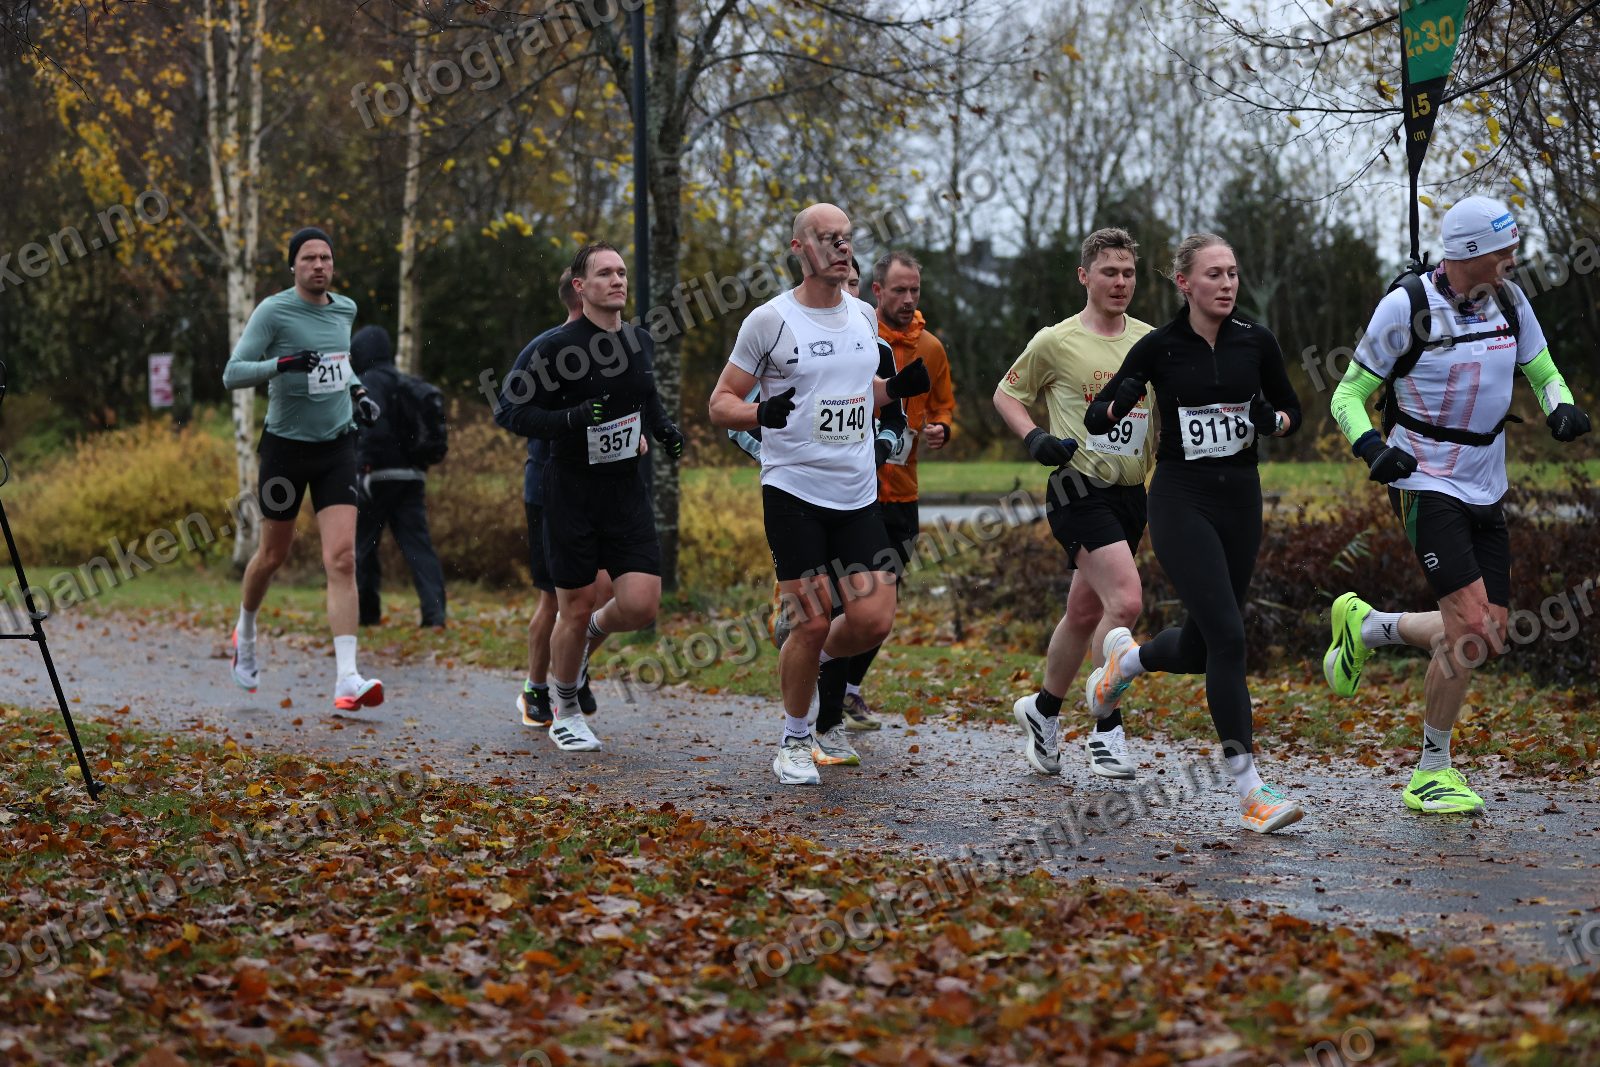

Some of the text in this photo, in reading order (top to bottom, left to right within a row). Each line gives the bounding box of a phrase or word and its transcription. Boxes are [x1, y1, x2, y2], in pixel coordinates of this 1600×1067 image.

[318, 363, 342, 383] 211
[1082, 383, 1107, 392] BER
[820, 396, 866, 406] NORGESTESTEN
[820, 406, 864, 432] 2140
[1186, 406, 1246, 417] NORGESTESTEN
[592, 416, 637, 432] NORGESTESTEN
[1188, 415, 1248, 446] 9118
[600, 427, 632, 453] 357
